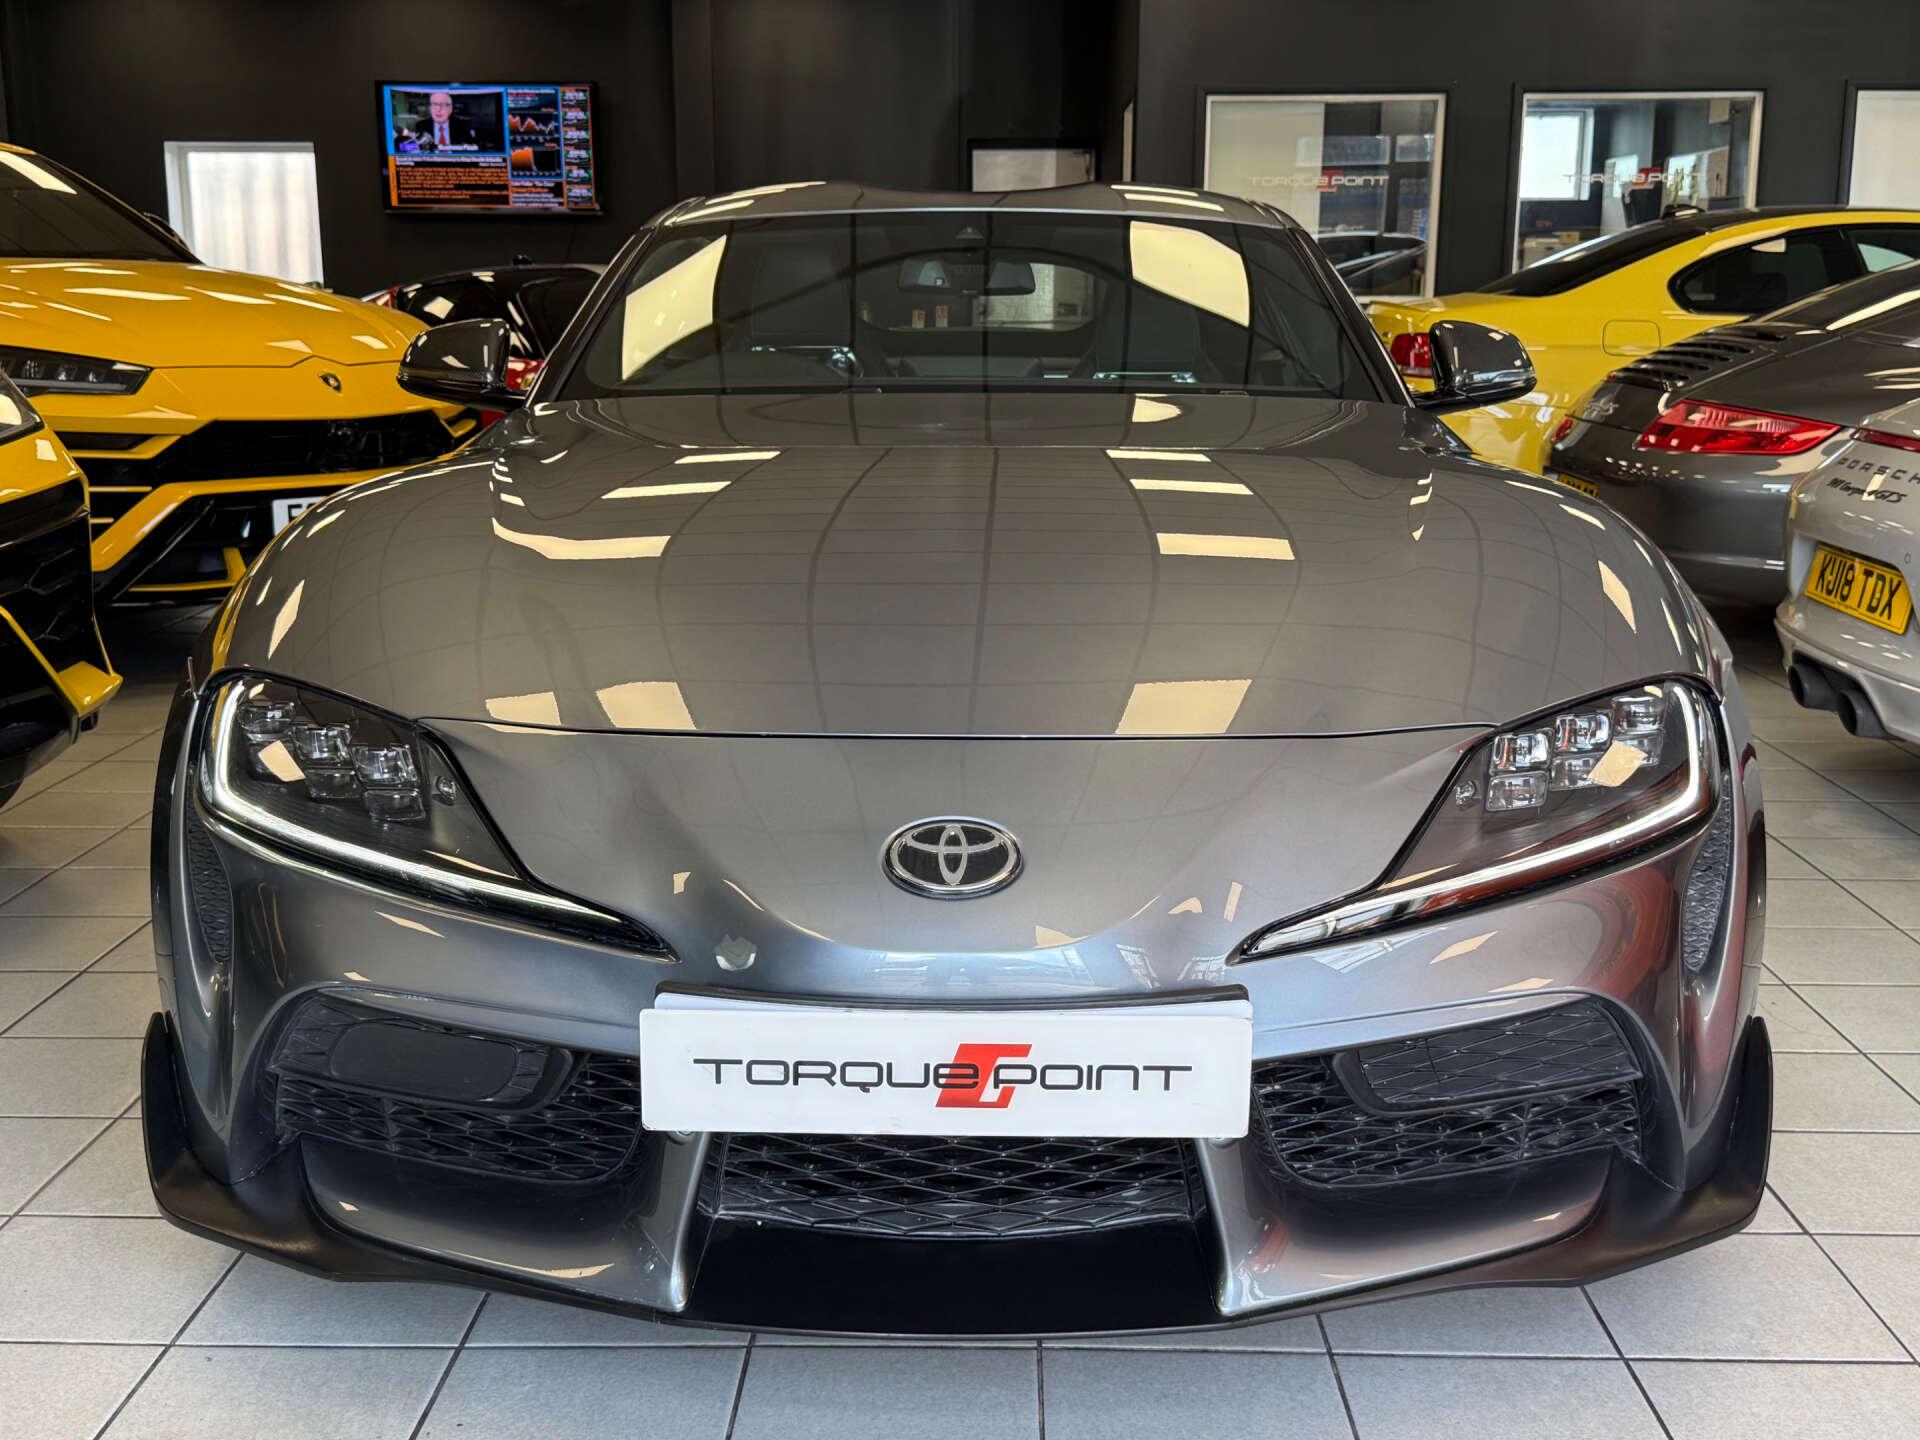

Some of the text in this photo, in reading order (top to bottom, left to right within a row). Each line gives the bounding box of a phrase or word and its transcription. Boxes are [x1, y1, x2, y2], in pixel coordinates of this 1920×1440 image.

[1331, 175, 1389, 186] POINT
[1815, 554, 1902, 620] KU18 TDX
[693, 1058, 1193, 1094] TORQUE POINT
